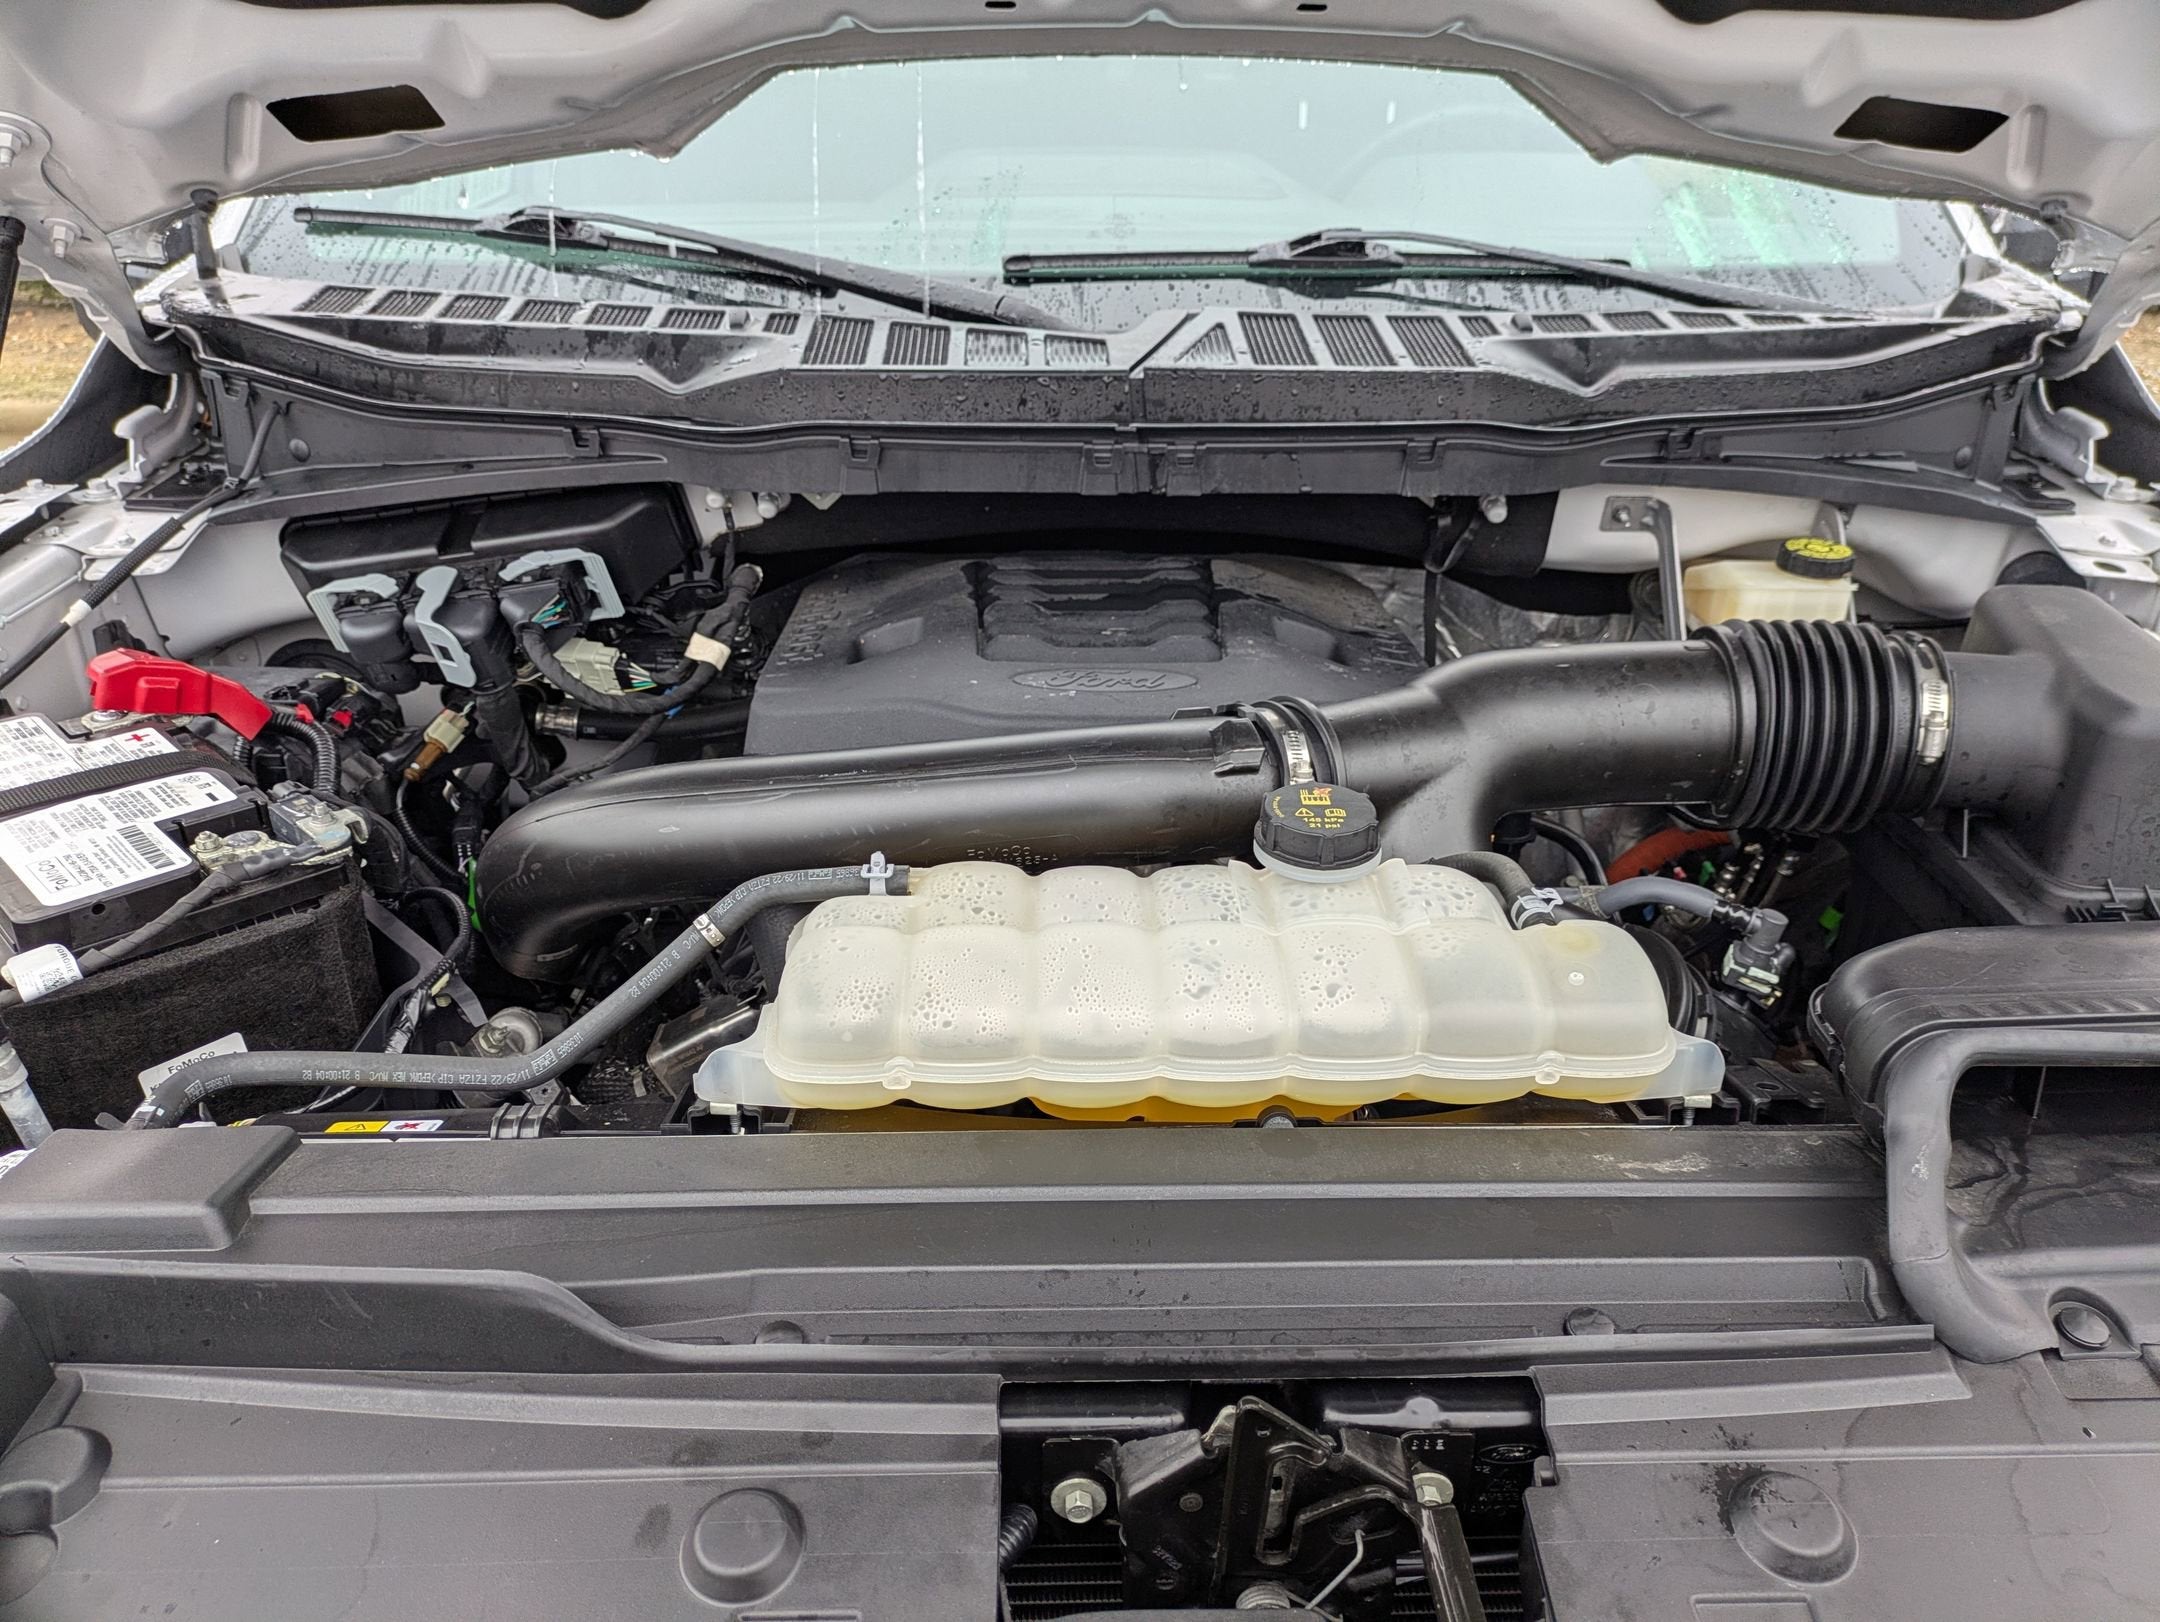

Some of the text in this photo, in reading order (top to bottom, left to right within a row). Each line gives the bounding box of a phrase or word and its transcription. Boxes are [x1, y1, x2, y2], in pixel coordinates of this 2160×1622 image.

[1046, 669, 1167, 688] Ford
[315, 1069, 351, 1081] 21:00:04
[438, 1073, 454, 1084] CIP
[490, 1068, 531, 1085] 11/29/22
